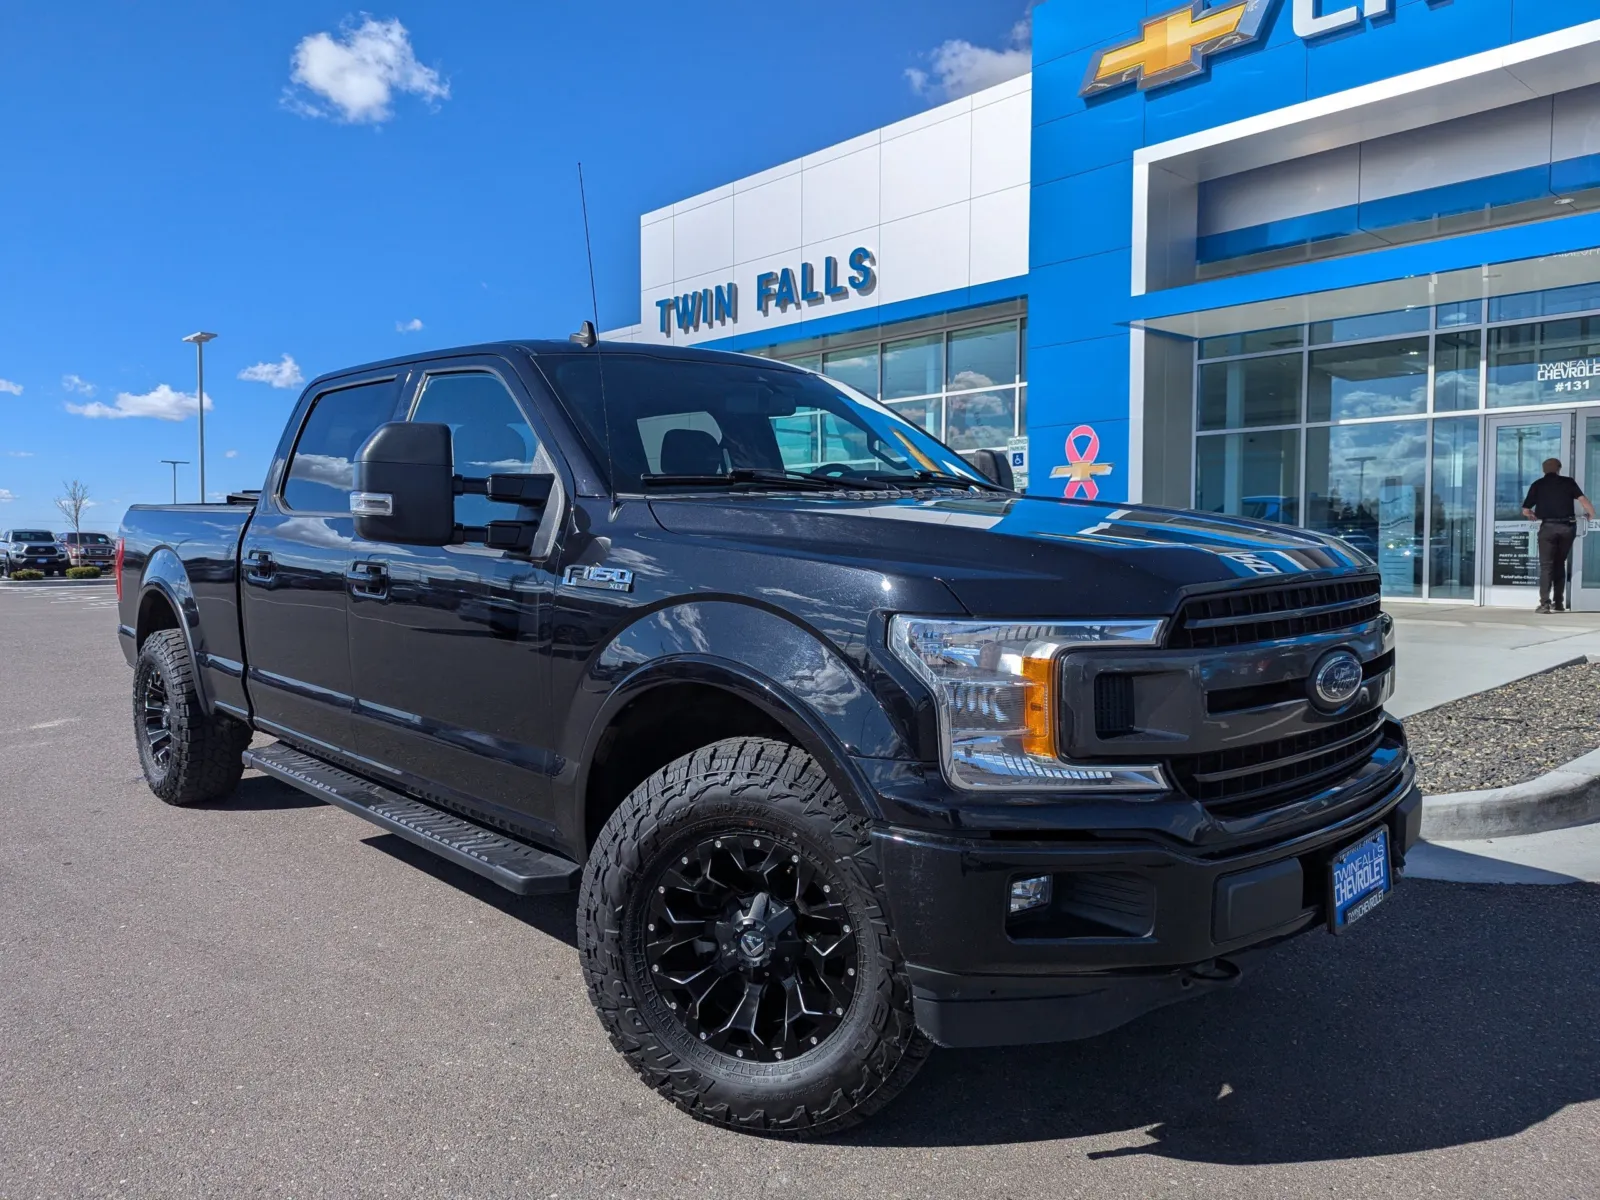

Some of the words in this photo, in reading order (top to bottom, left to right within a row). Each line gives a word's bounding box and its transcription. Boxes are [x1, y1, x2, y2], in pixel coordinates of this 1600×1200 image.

[656, 282, 738, 338] TWIN
[757, 247, 876, 317] FALLS
[1555, 380, 1590, 392] #131
[1334, 844, 1385, 884] TWINFALLS
[1334, 858, 1384, 908] CHEVROLET
